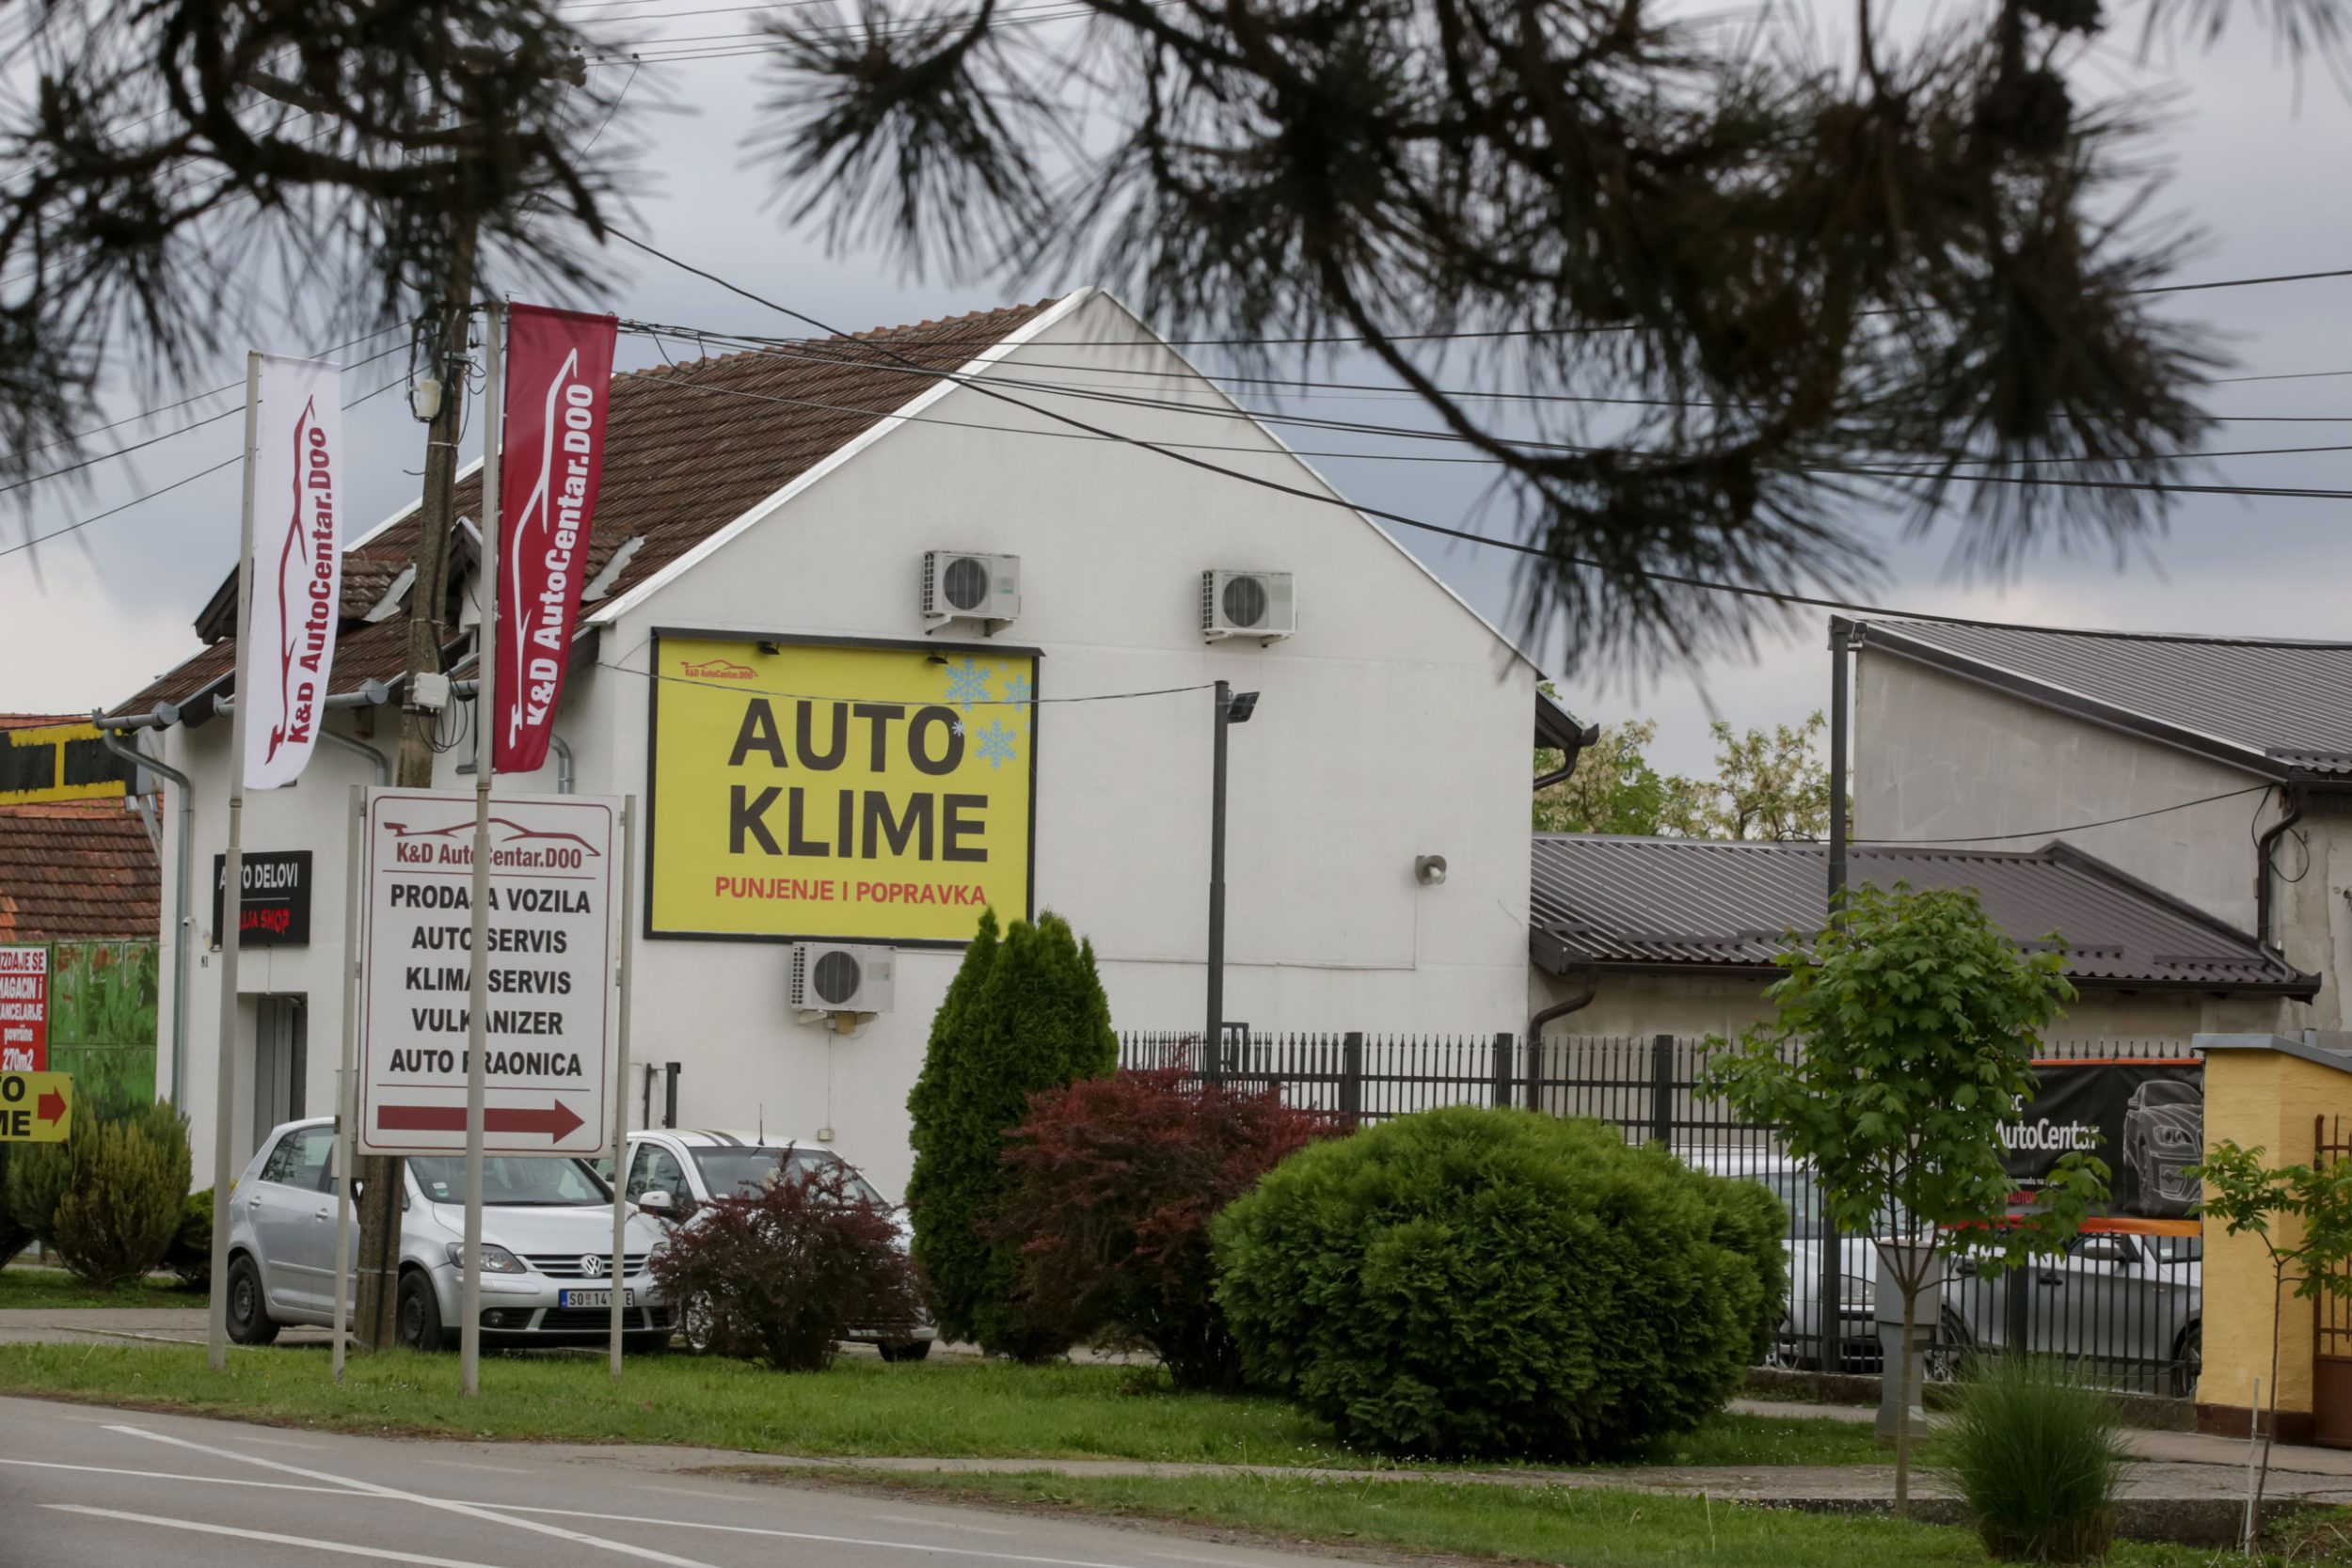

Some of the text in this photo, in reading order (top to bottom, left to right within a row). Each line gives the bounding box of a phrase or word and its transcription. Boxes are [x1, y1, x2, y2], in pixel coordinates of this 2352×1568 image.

[526, 659, 557, 725] K&D
[287, 683, 313, 743] K&D
[727, 698, 965, 776] AUTO
[729, 784, 989, 863] KLIME
[396, 842, 434, 863] K&D
[254, 863, 298, 888] DELOVI
[390, 883, 591, 913] PRODAA VOZILA
[715, 876, 986, 906] PUNJENJE I POPRAVKA
[486, 928, 567, 954] SERVIS
[0, 951, 44, 971] ZDAJE SE
[487, 969, 571, 995] SERVIS
[389, 1049, 454, 1073] AUTO
